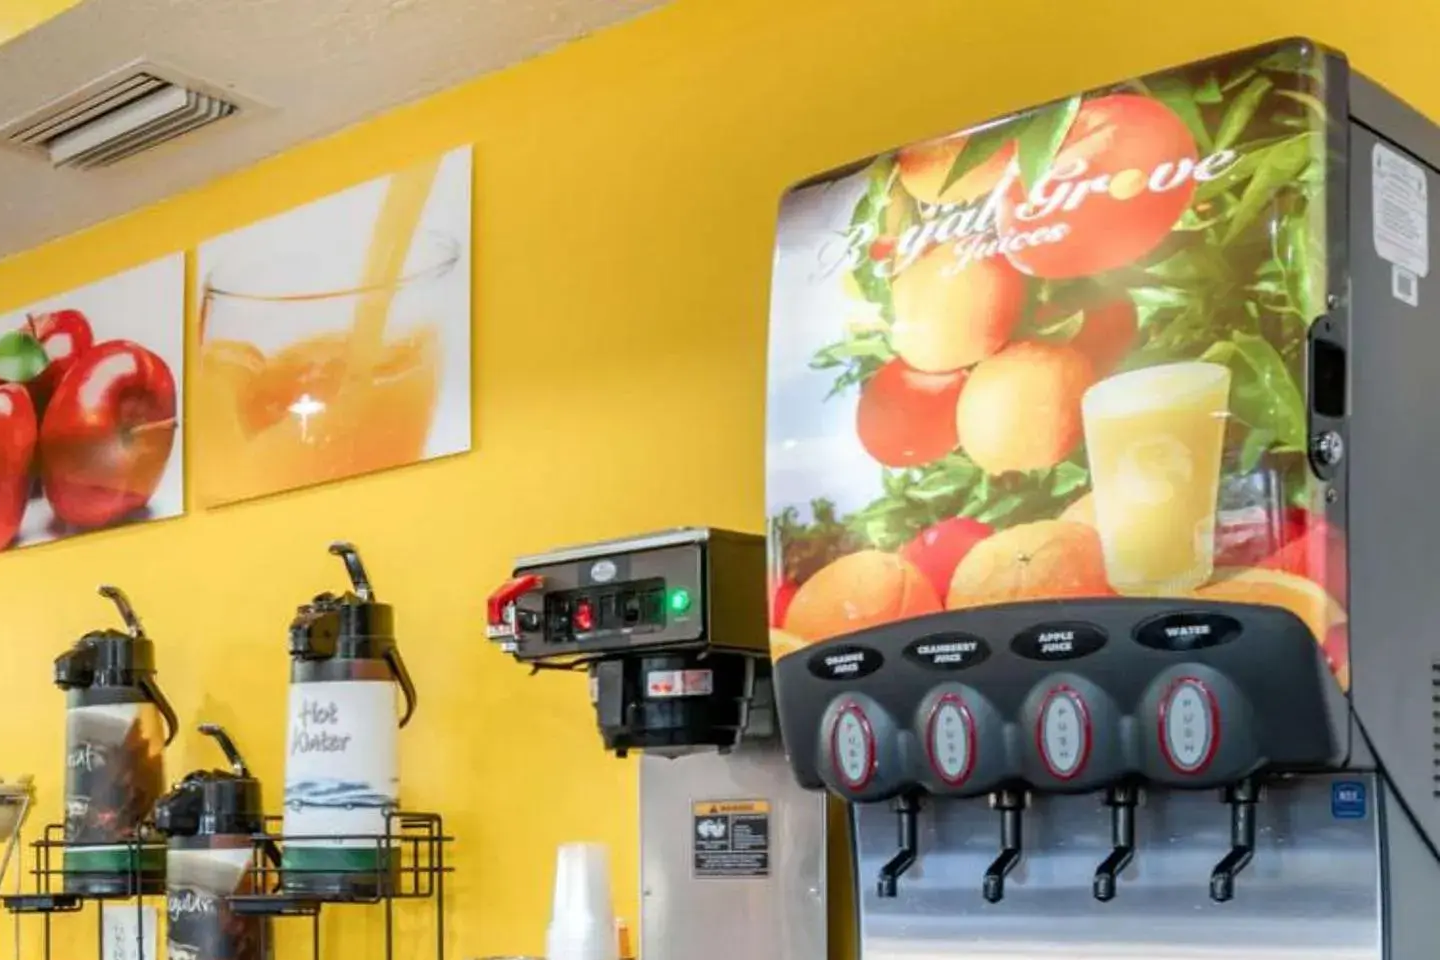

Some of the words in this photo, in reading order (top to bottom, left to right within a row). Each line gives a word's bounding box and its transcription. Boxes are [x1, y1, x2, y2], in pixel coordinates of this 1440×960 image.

[812, 154, 1026, 280] Royal
[1015, 148, 1239, 220] Grove
[1038, 631, 1074, 643] APPLE
[1165, 624, 1210, 638] WATER
[917, 642, 977, 655] CRANBERRY
[1041, 641, 1072, 653] JUICE
[825, 652, 864, 666] ORANGE
[934, 653, 961, 664] JUICE
[298, 697, 338, 727] Hot
[291, 725, 351, 756] Water
